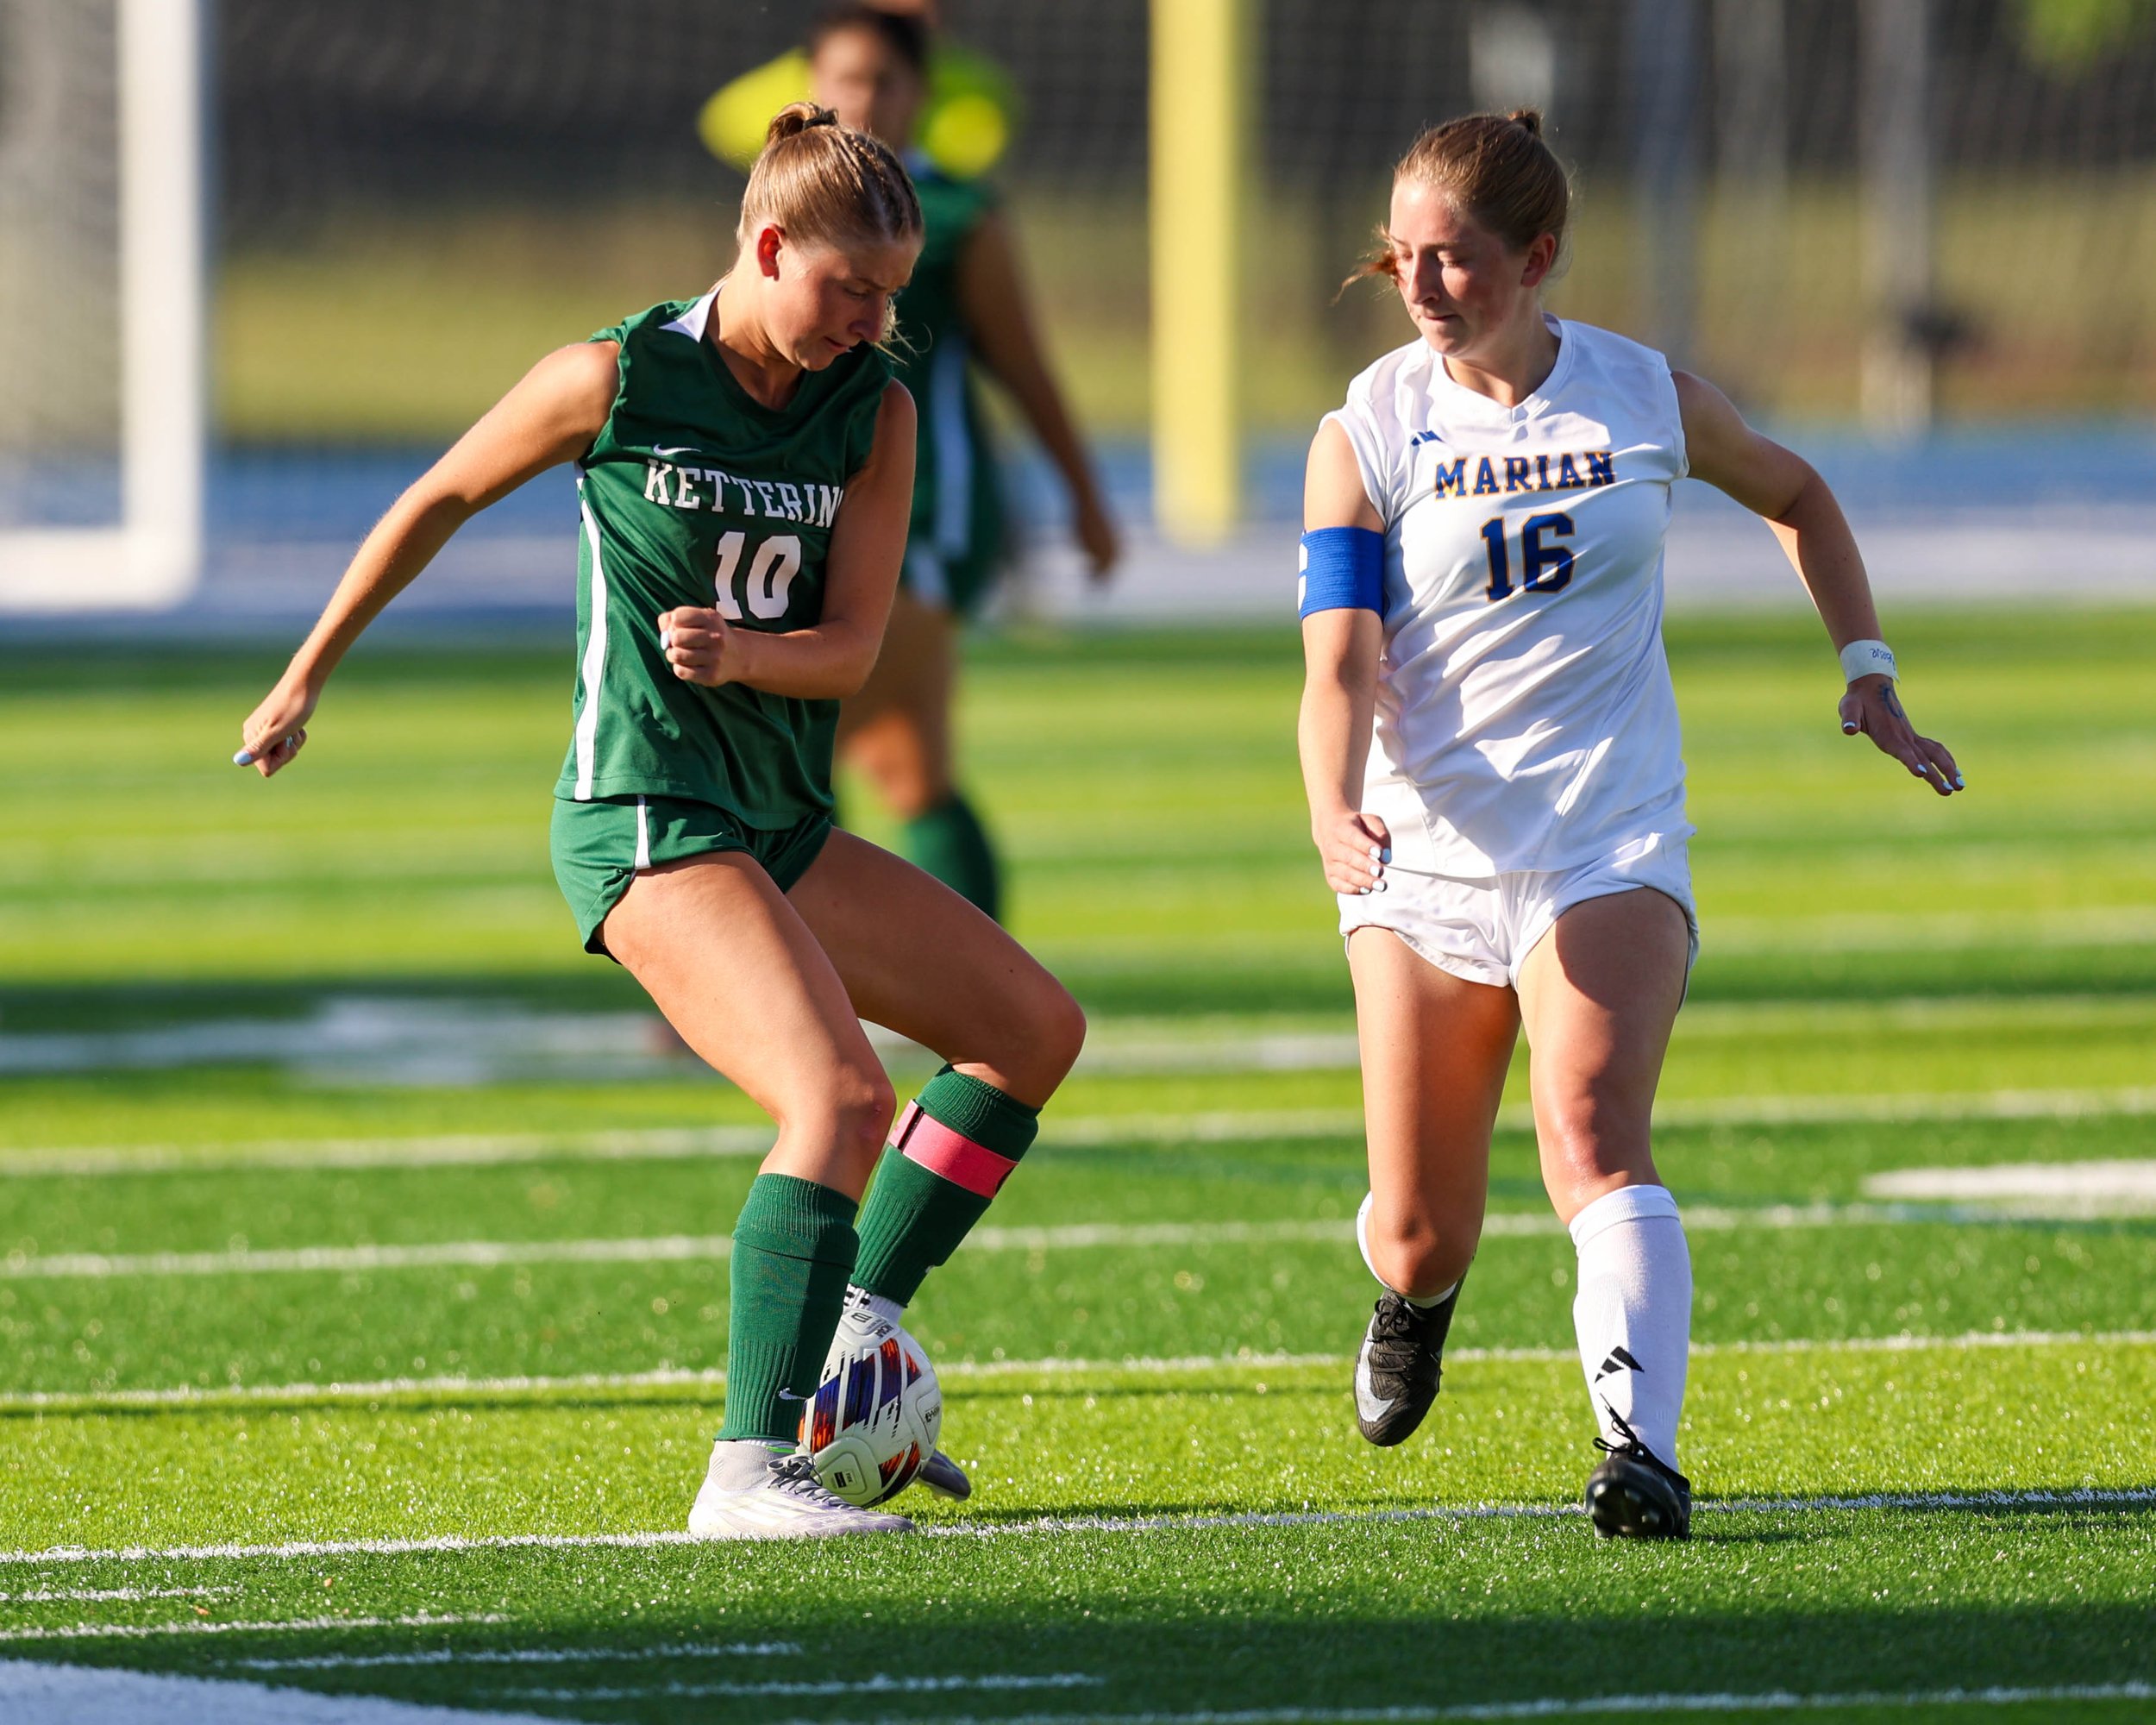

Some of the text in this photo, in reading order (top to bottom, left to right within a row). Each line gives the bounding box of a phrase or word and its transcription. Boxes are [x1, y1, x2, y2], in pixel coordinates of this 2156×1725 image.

[644, 459, 843, 528] KETTERIN
[1434, 451, 1616, 499] MARIAN
[715, 530, 801, 620] 10
[1480, 511, 1576, 603] 16
